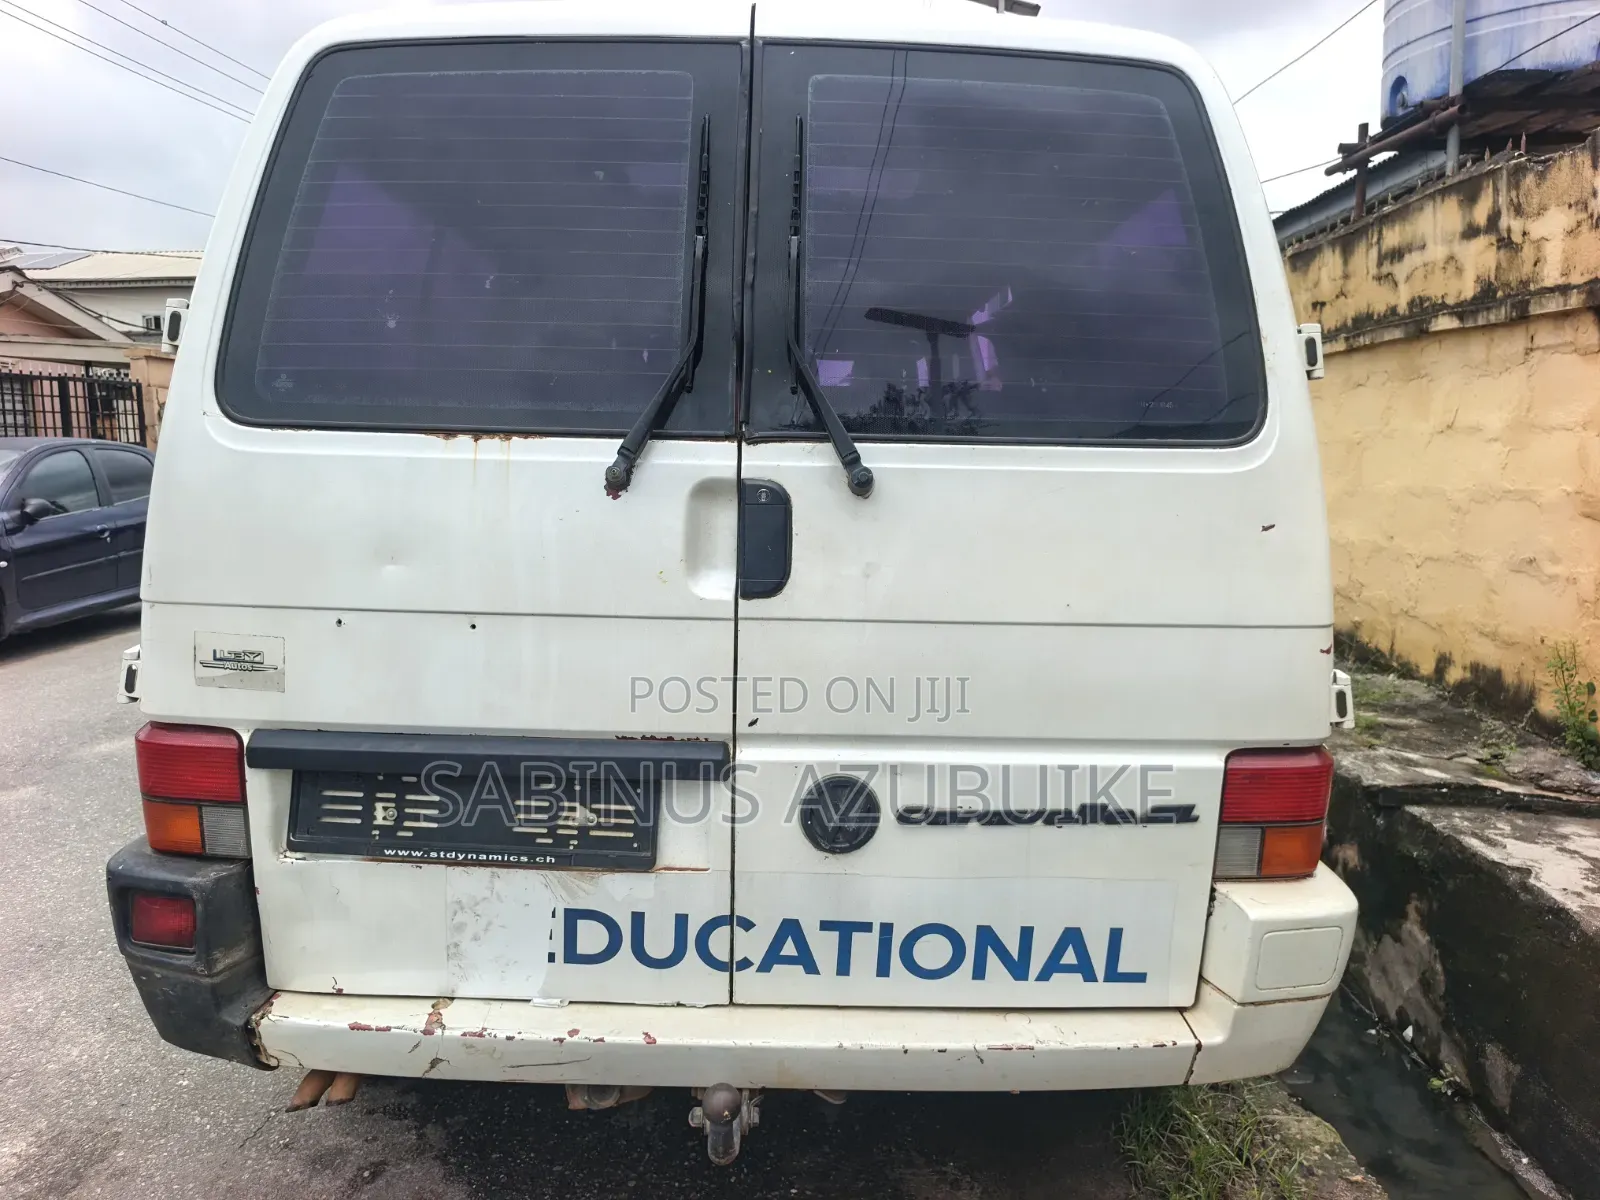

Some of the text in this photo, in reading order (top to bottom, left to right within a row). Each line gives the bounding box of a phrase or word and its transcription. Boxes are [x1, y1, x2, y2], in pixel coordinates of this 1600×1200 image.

[224, 661, 253, 671] Autos
[384, 849, 556, 864] www.stdynamics.ch
[547, 907, 1148, 984] DUCATIONAL
